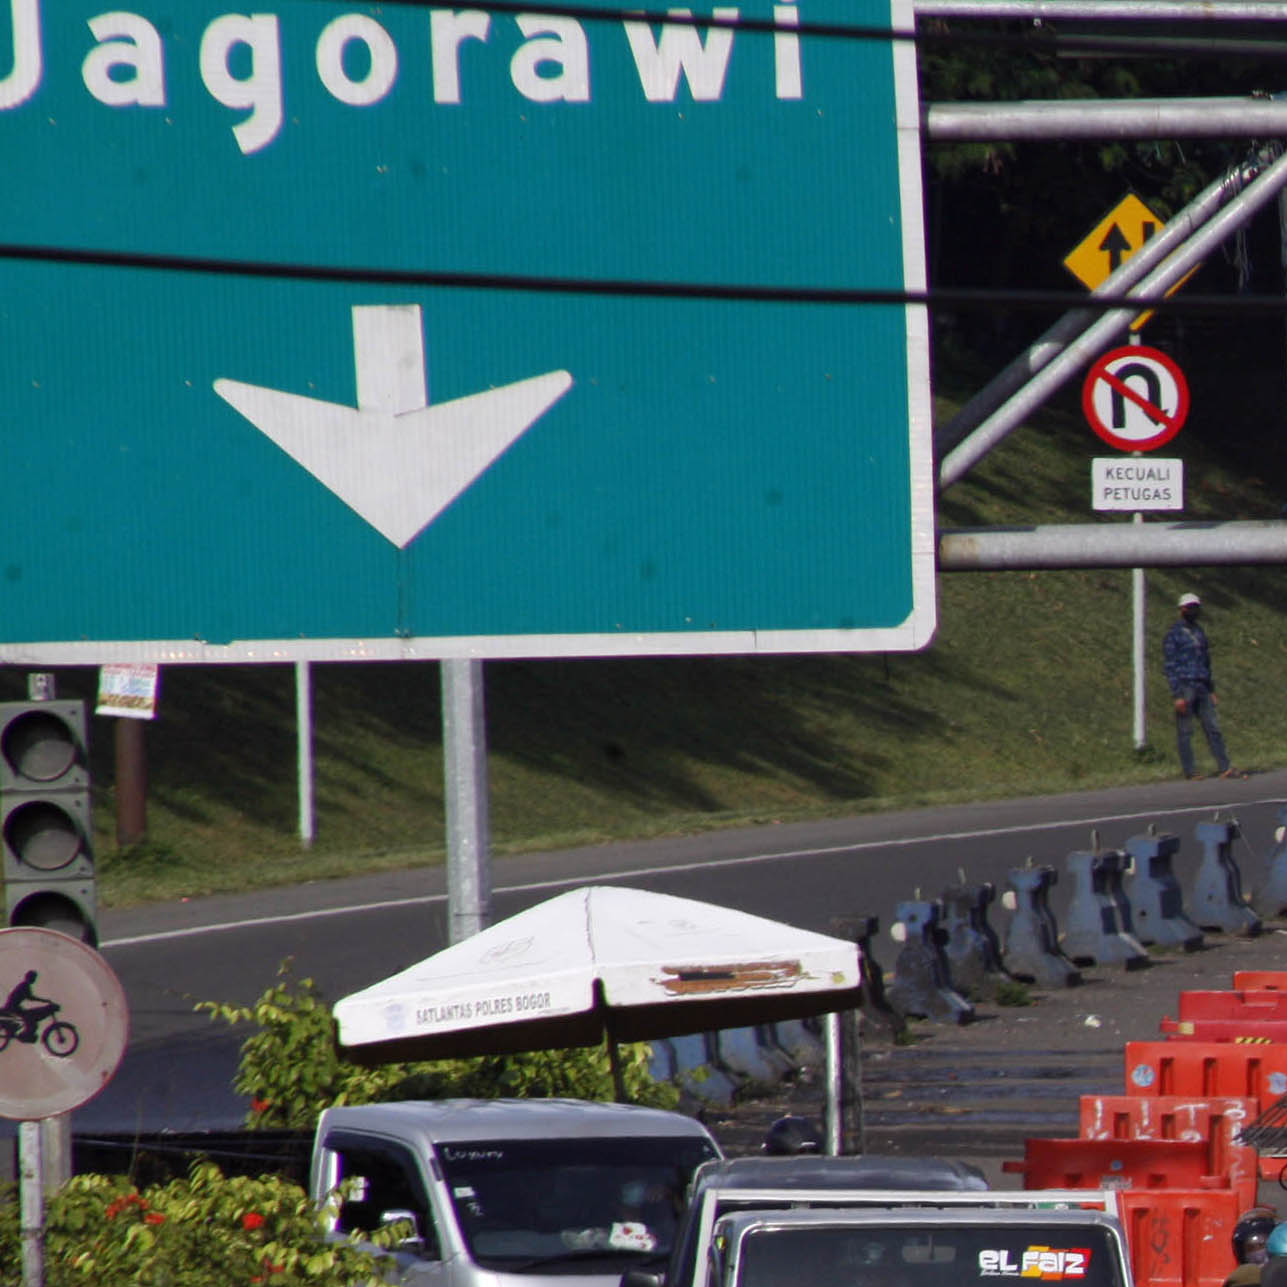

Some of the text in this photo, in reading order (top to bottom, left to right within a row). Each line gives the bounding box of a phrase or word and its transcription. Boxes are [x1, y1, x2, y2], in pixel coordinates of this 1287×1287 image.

[1104, 466, 1170, 481] KECUALI
[1104, 487, 1172, 501] PETUGAS
[416, 992, 551, 1025] SATLANTAS POLRES BOGOR
